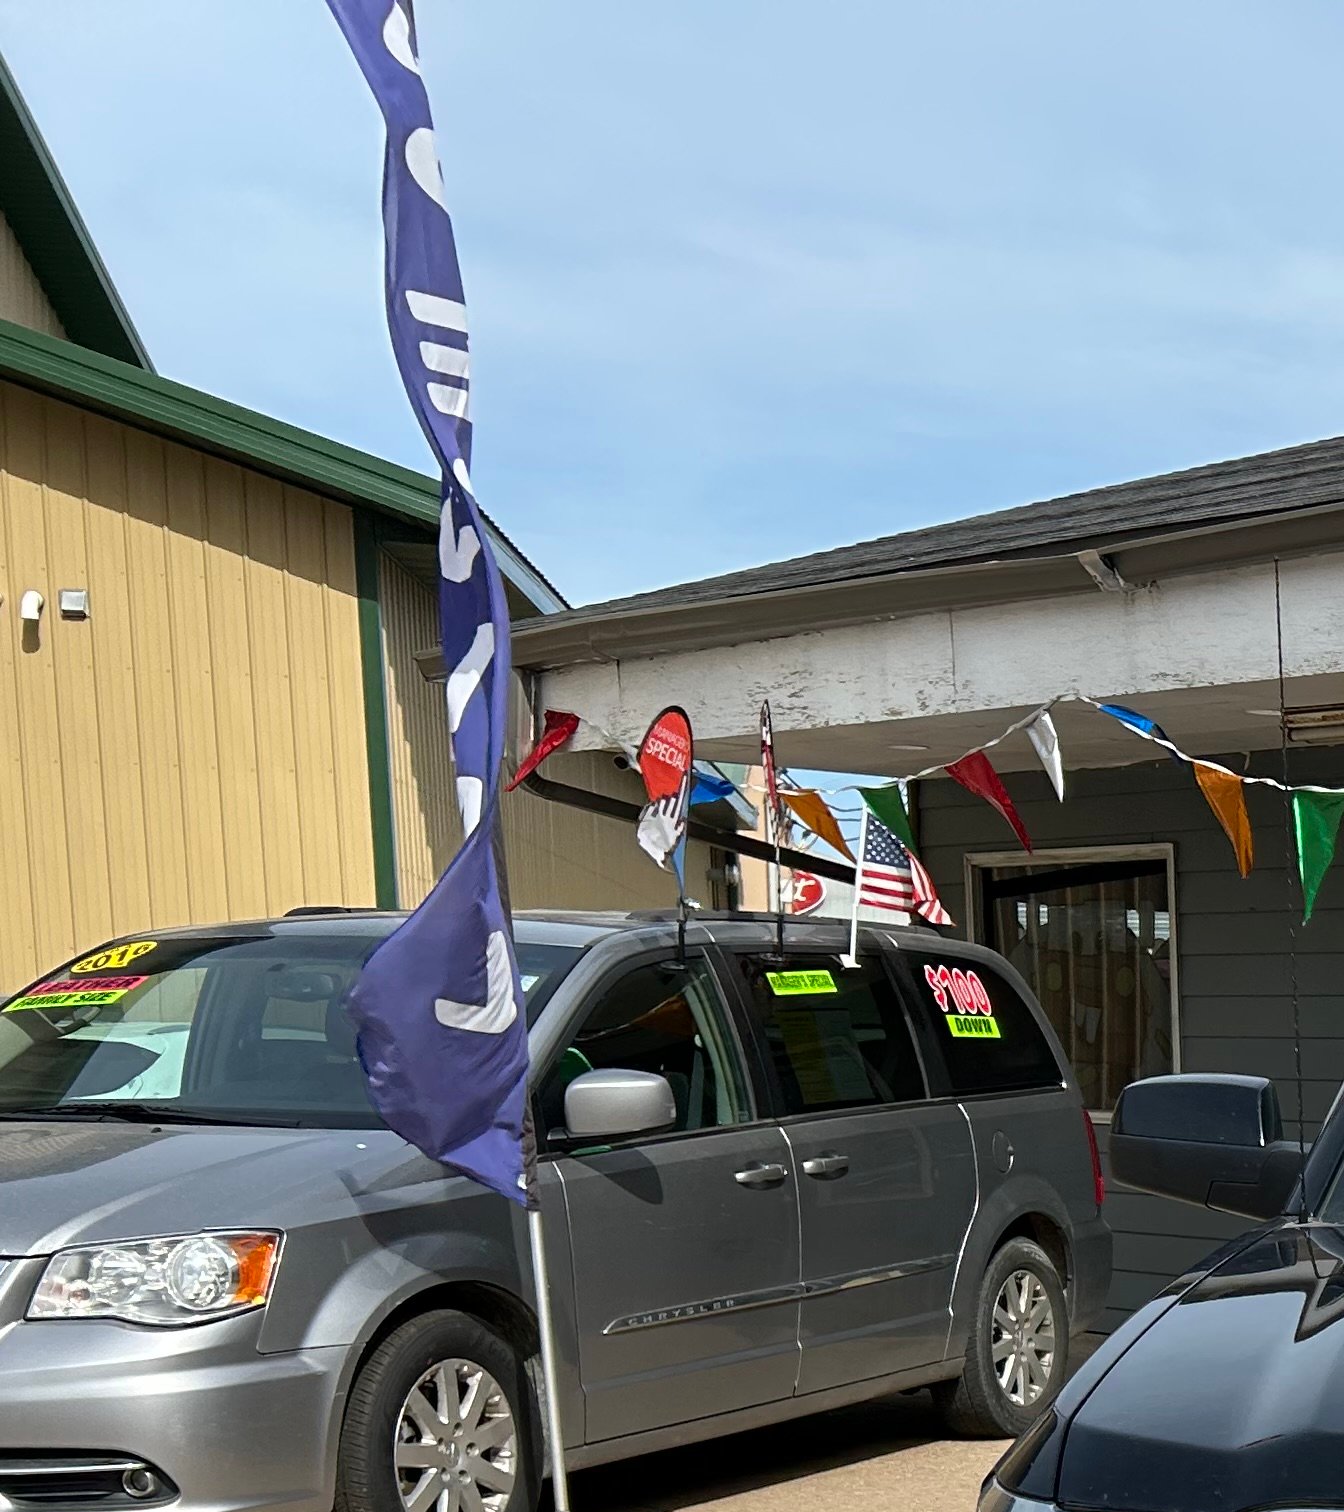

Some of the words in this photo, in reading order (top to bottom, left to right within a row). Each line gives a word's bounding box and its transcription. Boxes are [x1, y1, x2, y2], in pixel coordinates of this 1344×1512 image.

[645, 737, 687, 771] SPECIAL
[954, 1017, 993, 1034] DOWN
[627, 1299, 736, 1326] CHRYSLER
